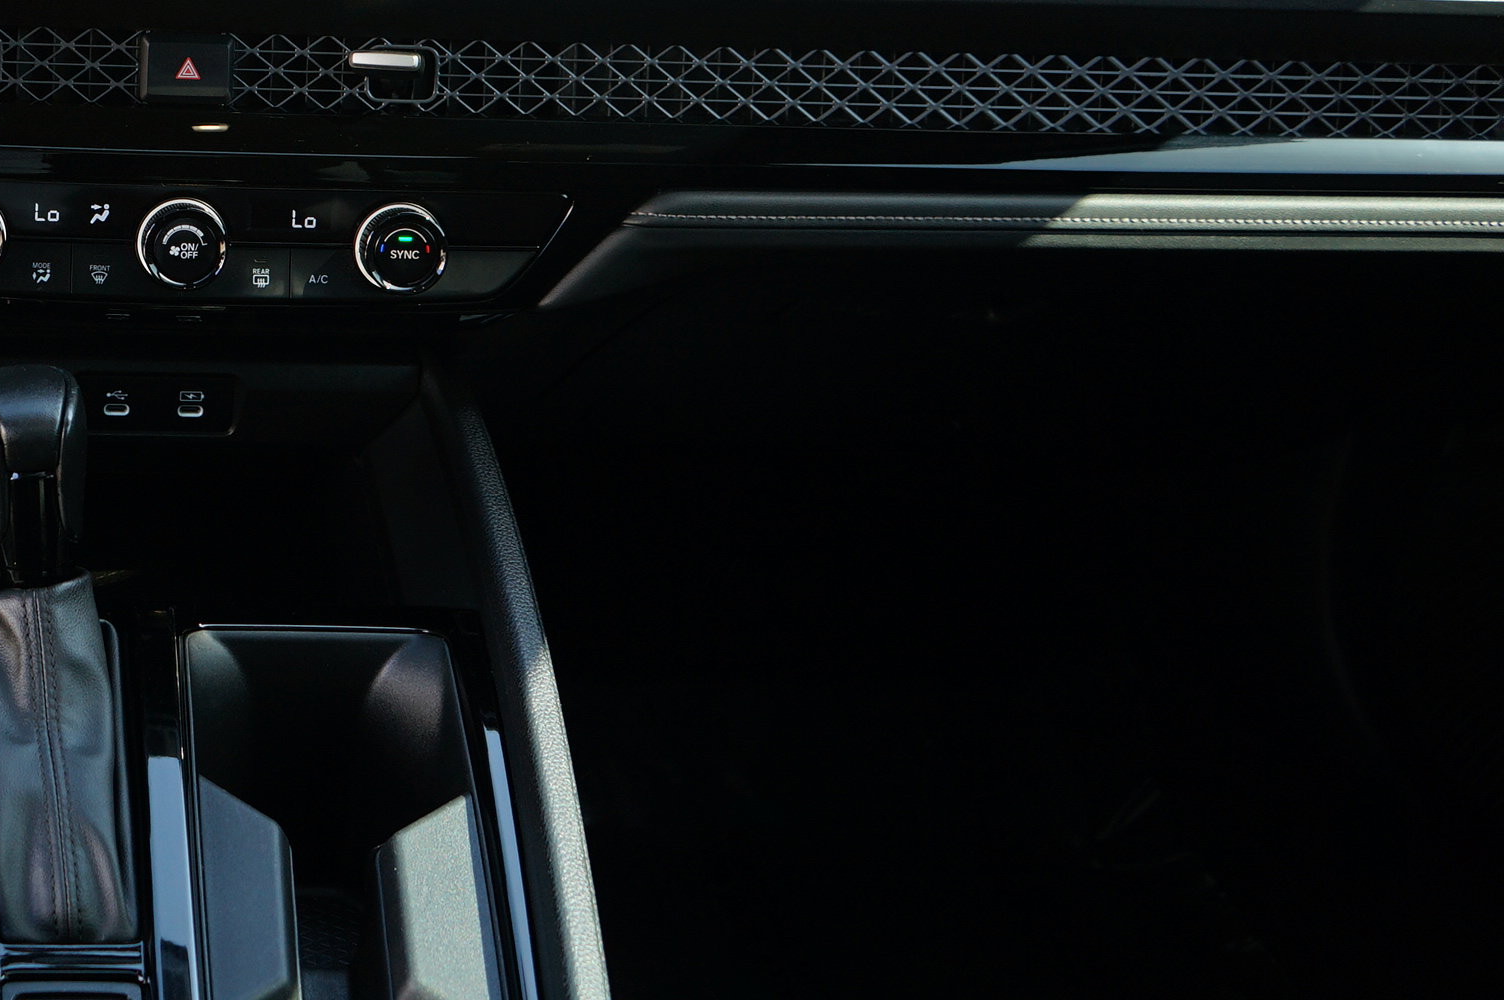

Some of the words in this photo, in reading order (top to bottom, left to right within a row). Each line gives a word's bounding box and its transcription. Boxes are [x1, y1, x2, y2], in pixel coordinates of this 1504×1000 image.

[180, 242, 199, 252] ON/
[180, 251, 198, 260] OFF
[390, 250, 420, 261] SYNC
[309, 275, 328, 284] A/C
